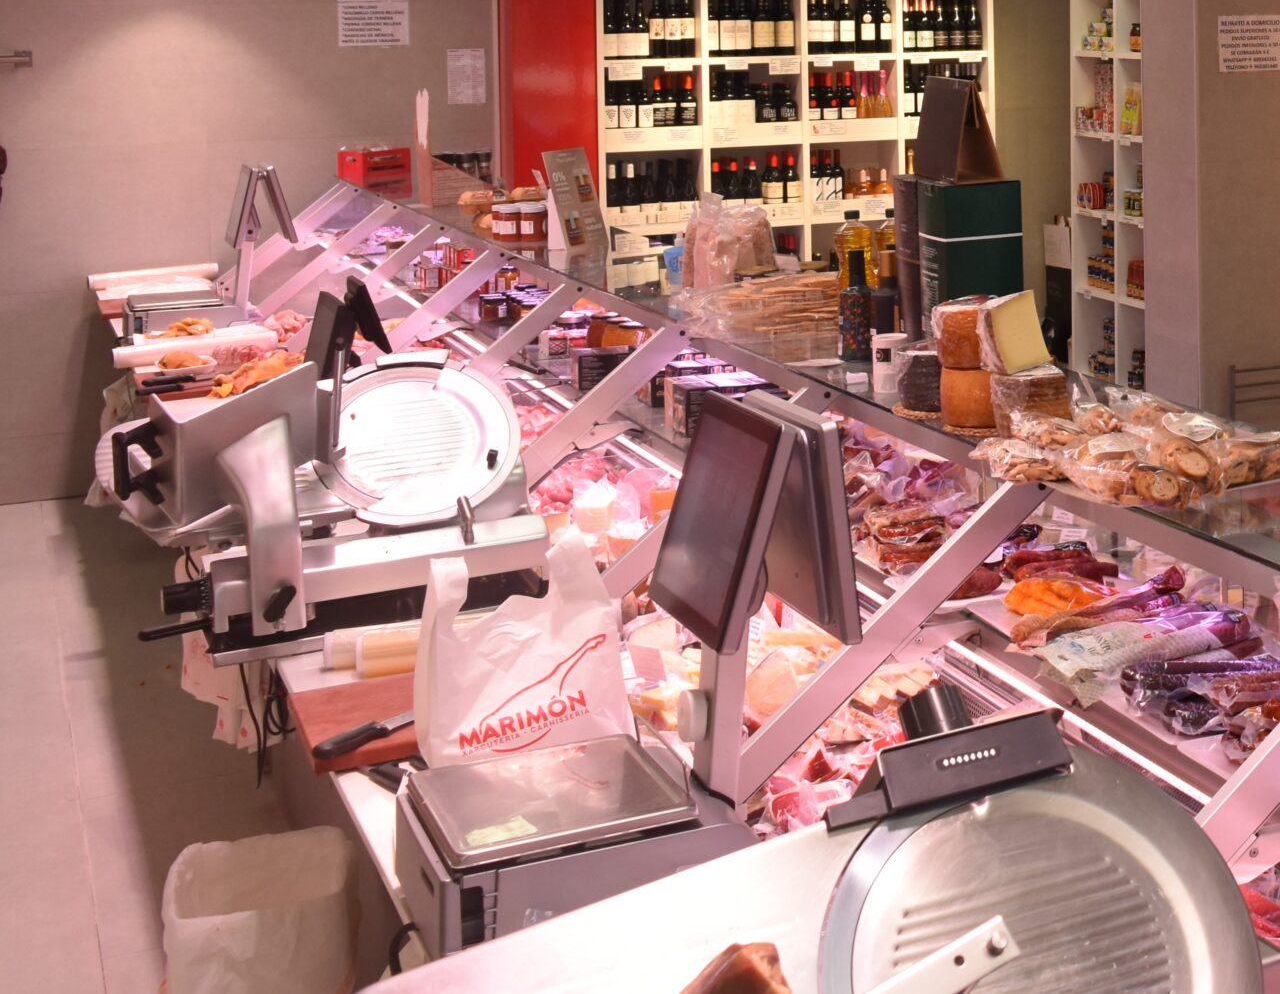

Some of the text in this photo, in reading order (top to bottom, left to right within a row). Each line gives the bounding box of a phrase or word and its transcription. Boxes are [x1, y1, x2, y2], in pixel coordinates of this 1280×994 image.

[459, 690, 588, 750] MARIMÓN
[462, 709, 590, 757] XARCUTERIA CARNISSERIA
